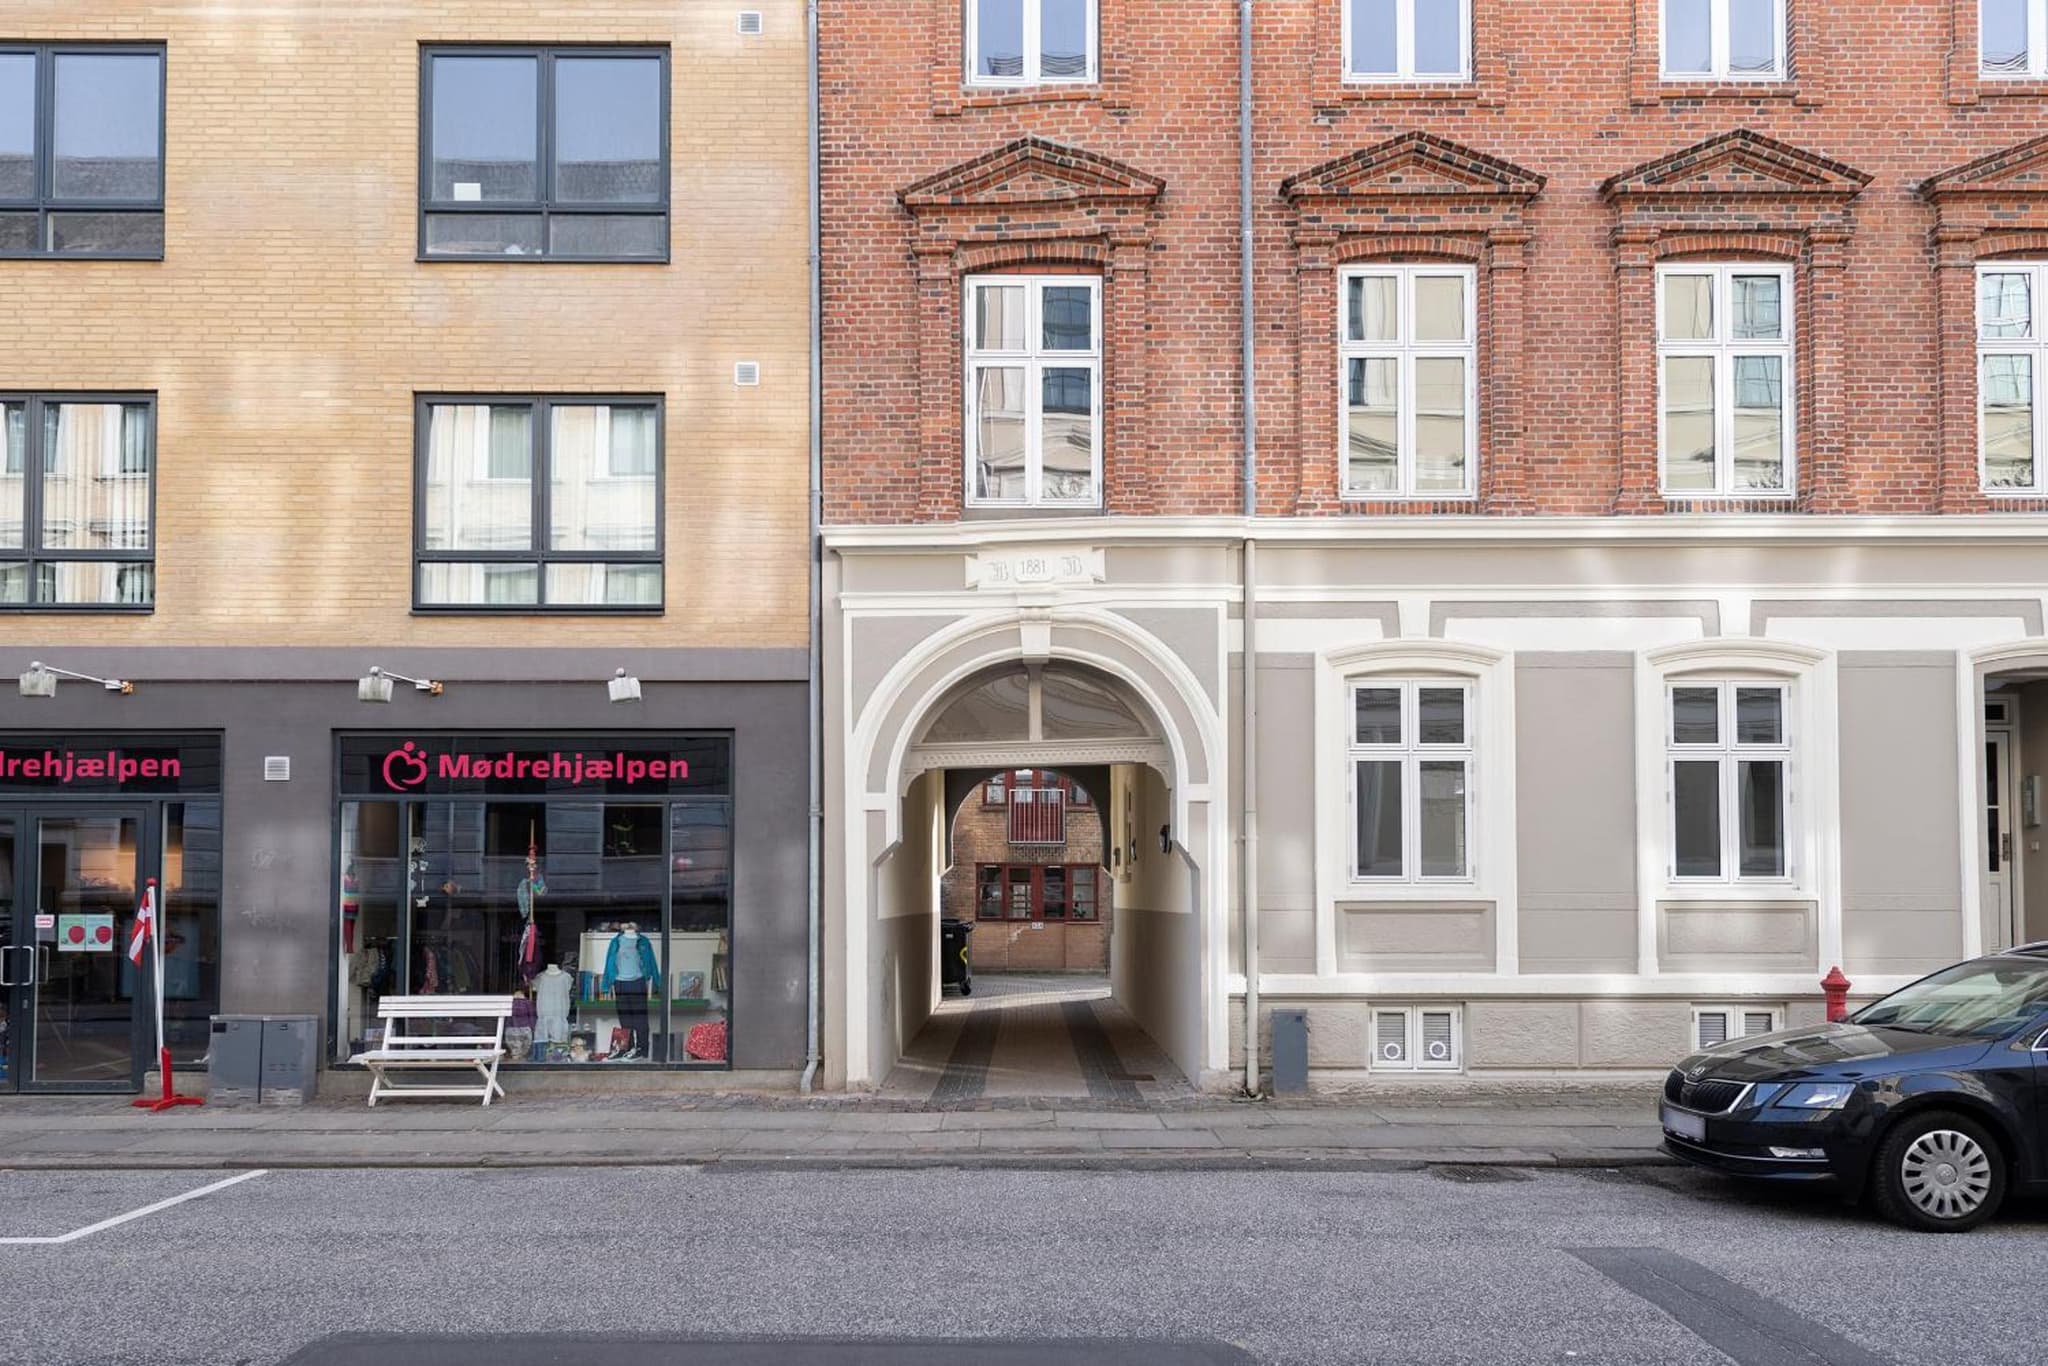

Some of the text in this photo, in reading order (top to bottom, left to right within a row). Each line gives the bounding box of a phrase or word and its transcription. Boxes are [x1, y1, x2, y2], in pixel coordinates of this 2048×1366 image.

[1021, 559, 1046, 575] 1881
[0, 752, 181, 782] rehjælpen
[440, 753, 689, 783] Mødrehjælpen
